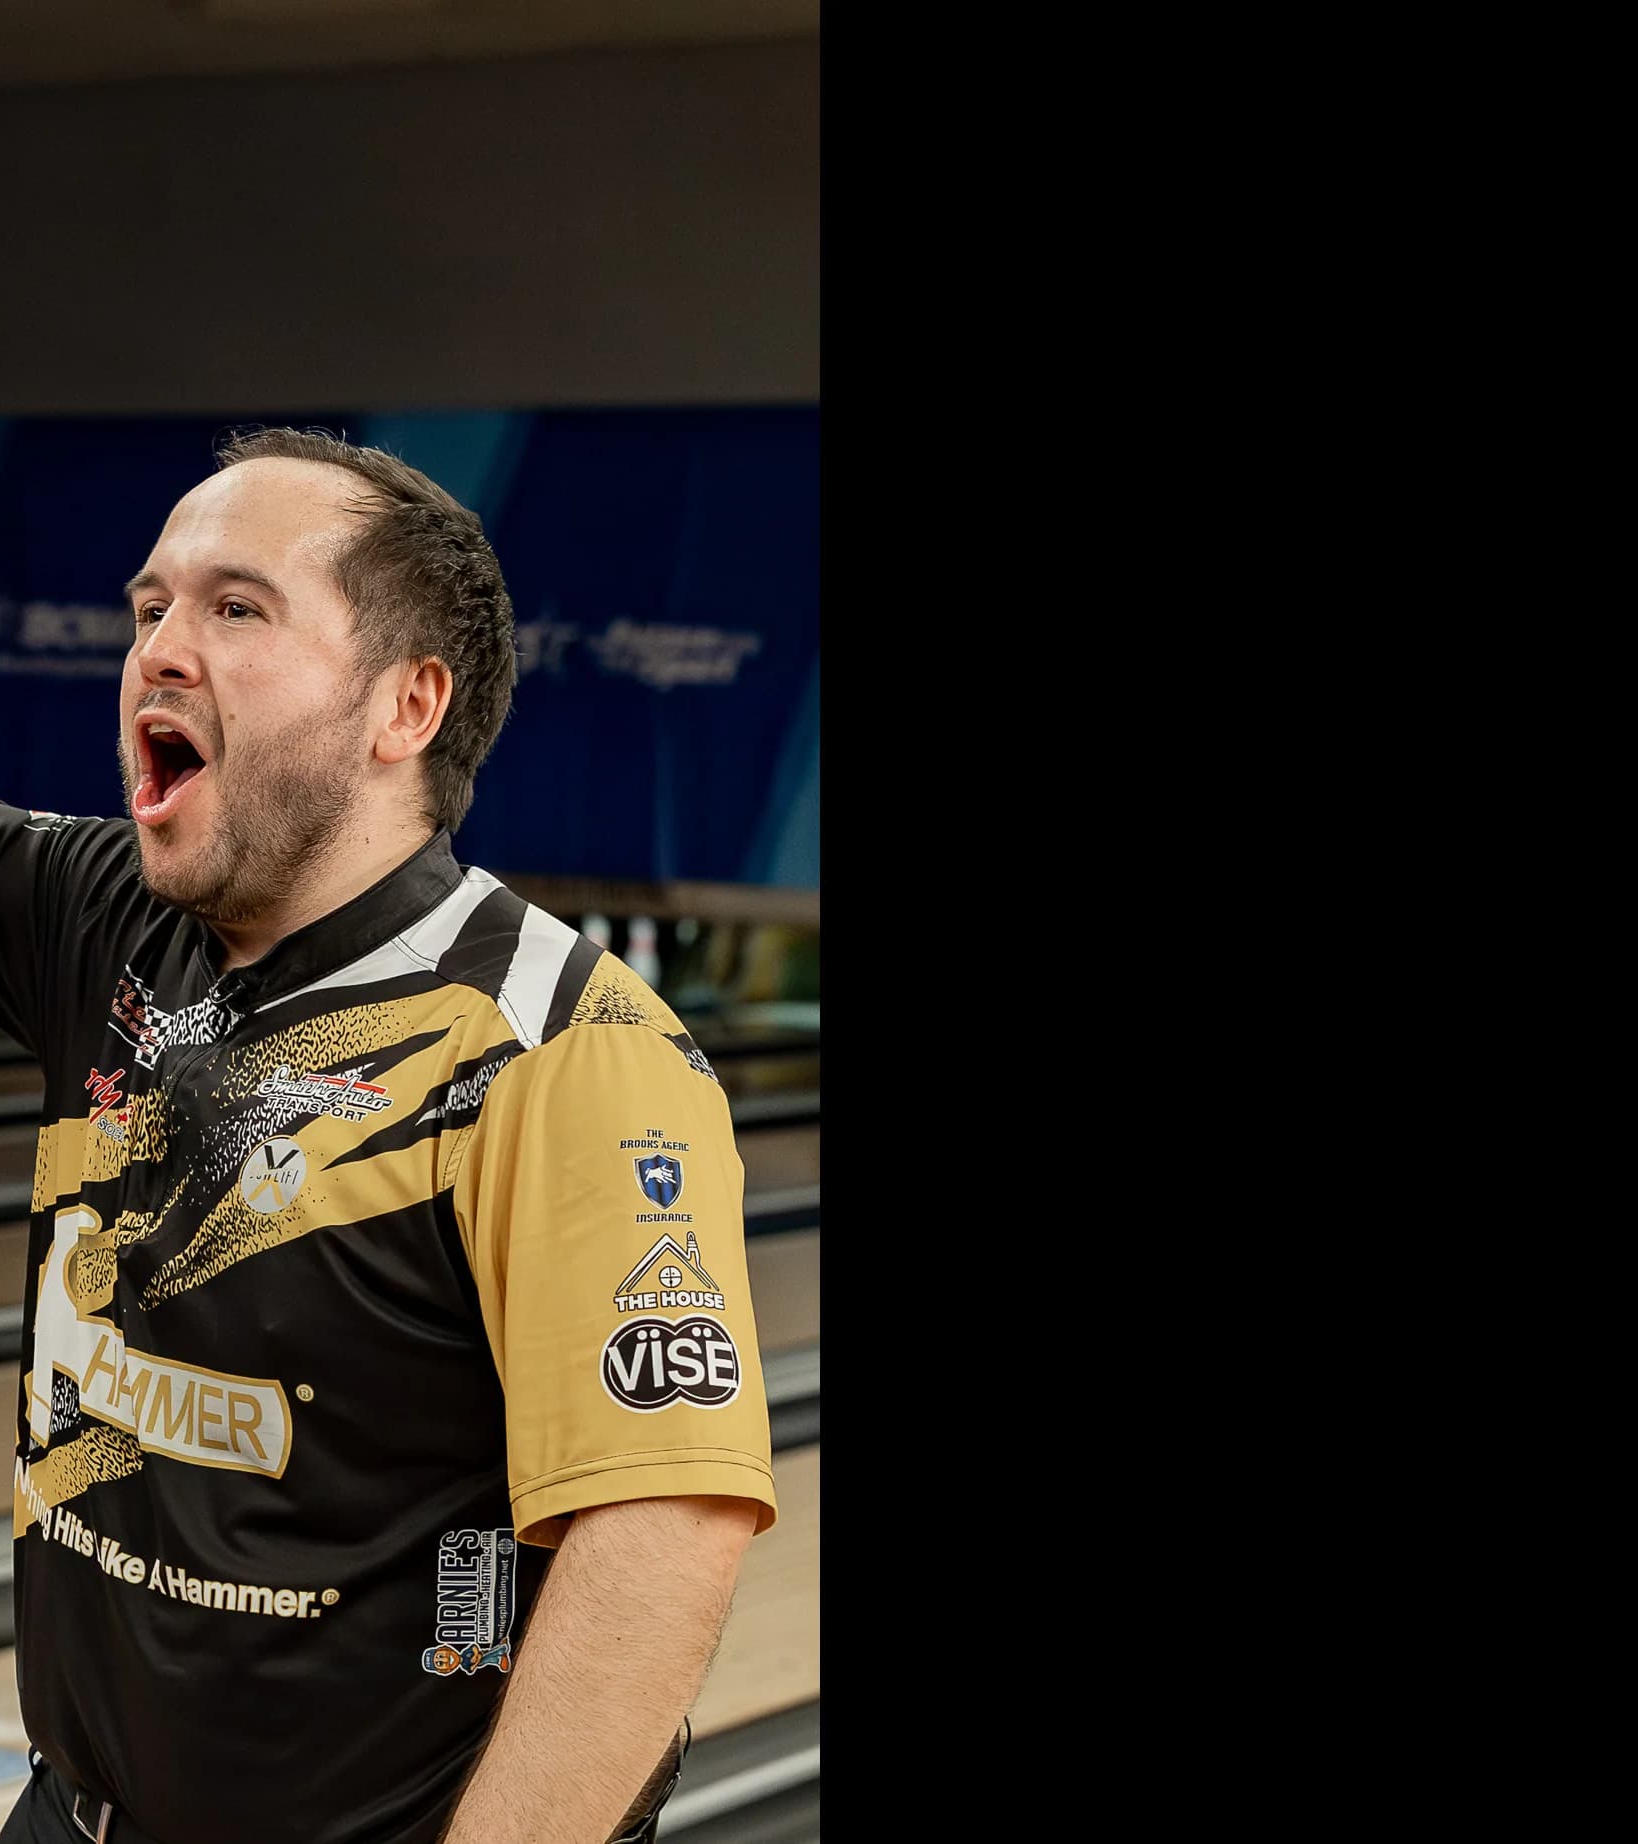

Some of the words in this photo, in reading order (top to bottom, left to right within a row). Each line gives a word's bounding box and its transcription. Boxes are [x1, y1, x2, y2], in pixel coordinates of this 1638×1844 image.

[266, 1097, 367, 1123] TRANSPORT
[619, 1139, 659, 1149] BROOKS
[646, 1129, 664, 1139] THE
[614, 1293, 658, 1312] THE
[660, 1290, 726, 1311] HOUSE
[53, 1506, 94, 1557] Hits
[147, 1558, 166, 1595] A
[436, 1529, 480, 1644] ARNIE'S
